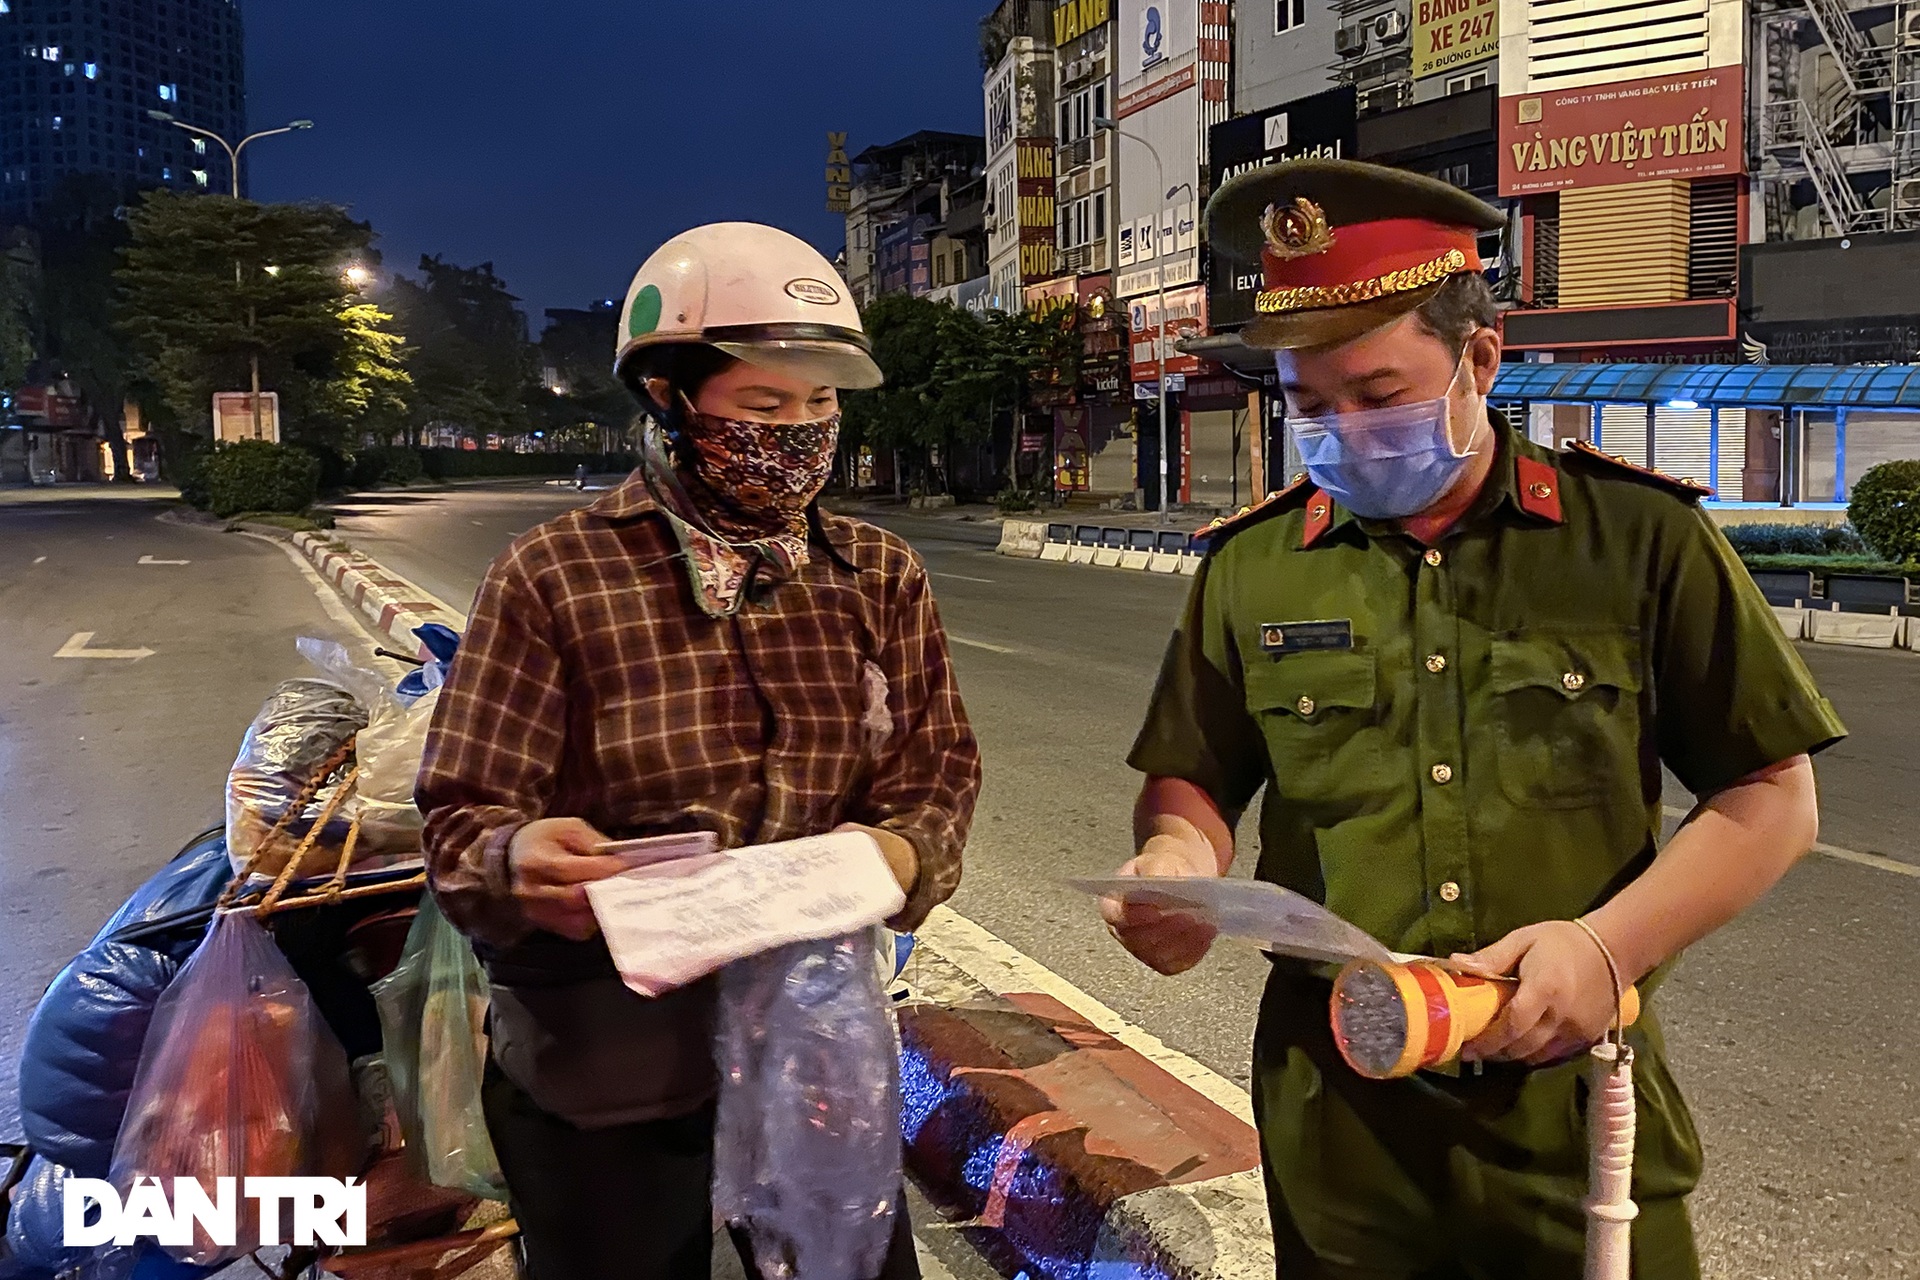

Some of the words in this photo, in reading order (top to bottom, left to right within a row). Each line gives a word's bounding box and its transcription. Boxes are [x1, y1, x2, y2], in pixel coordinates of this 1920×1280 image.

[1430, 24, 1453, 54] XE
[1460, 10, 1494, 44] 247
[1422, 61, 1434, 72] 26
[1436, 50, 1471, 68] ĐƯỜNG
[1555, 97, 1579, 106] CÔNG
[1595, 92, 1616, 101] TNHH
[1618, 88, 1640, 98] VÀNG
[1643, 86, 1660, 96] BẠC
[1662, 81, 1688, 93] VIỆT
[1691, 76, 1718, 90] TIẾN
[1512, 132, 1588, 173] VÀNG
[1590, 120, 1657, 168] VIỆT
[1660, 107, 1728, 158] TIẾN
[1017, 142, 1052, 178] VÀNG
[1018, 185, 1054, 228] NHẪN
[1236, 276, 1256, 290] ELY
